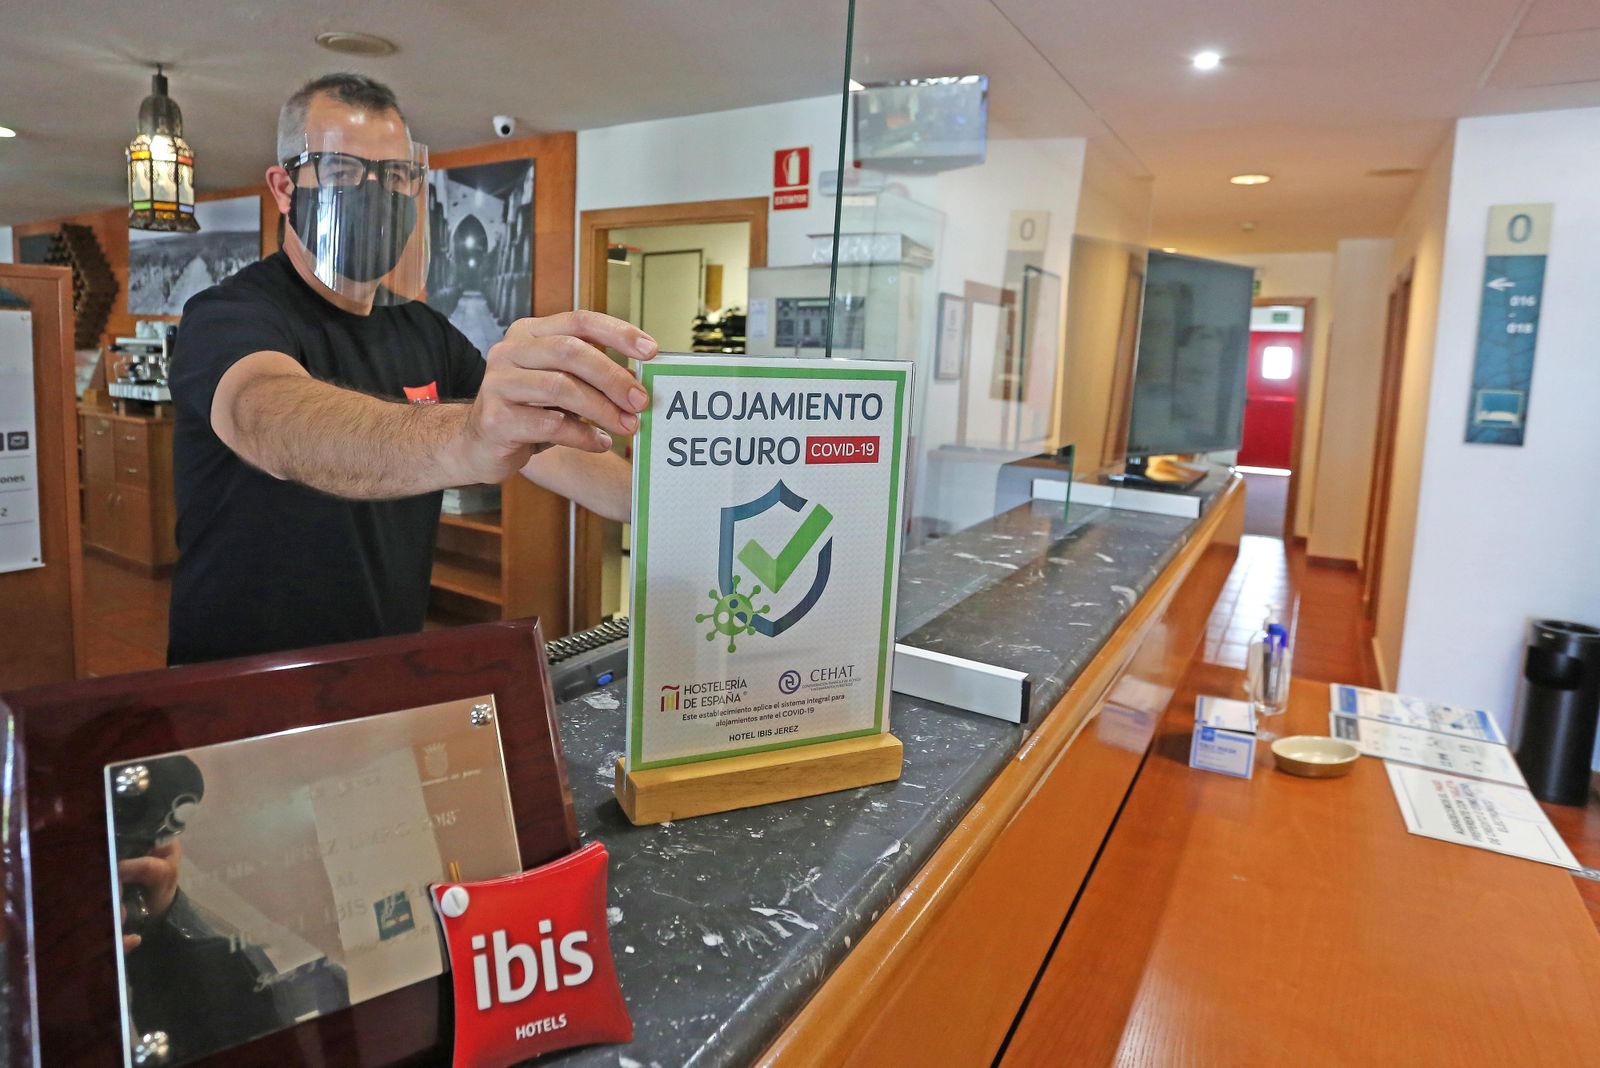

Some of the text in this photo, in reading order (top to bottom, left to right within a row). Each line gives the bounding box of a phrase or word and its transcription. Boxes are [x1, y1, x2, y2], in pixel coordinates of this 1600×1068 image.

[665, 390, 883, 421] ALOJAMIENTO
[666, 435, 876, 467] SEGURO COVID-19
[810, 665, 855, 682] CEHAT
[684, 677, 748, 695] HOSTELERÍA
[682, 713, 698, 721] Este
[699, 706, 752, 719] establecimiento
[753, 703, 773, 713] aplica
[780, 699, 806, 708] sistema
[806, 694, 831, 704] integral
[831, 694, 845, 703] para
[684, 691, 741, 709] DE ESPAÑA
[715, 707, 815, 727] alojamientos ante el COVID-19
[729, 725, 799, 742] HOTEL IBIS JEREZ
[471, 919, 595, 1011] ibis
[515, 1013, 567, 1040] HOTELS
